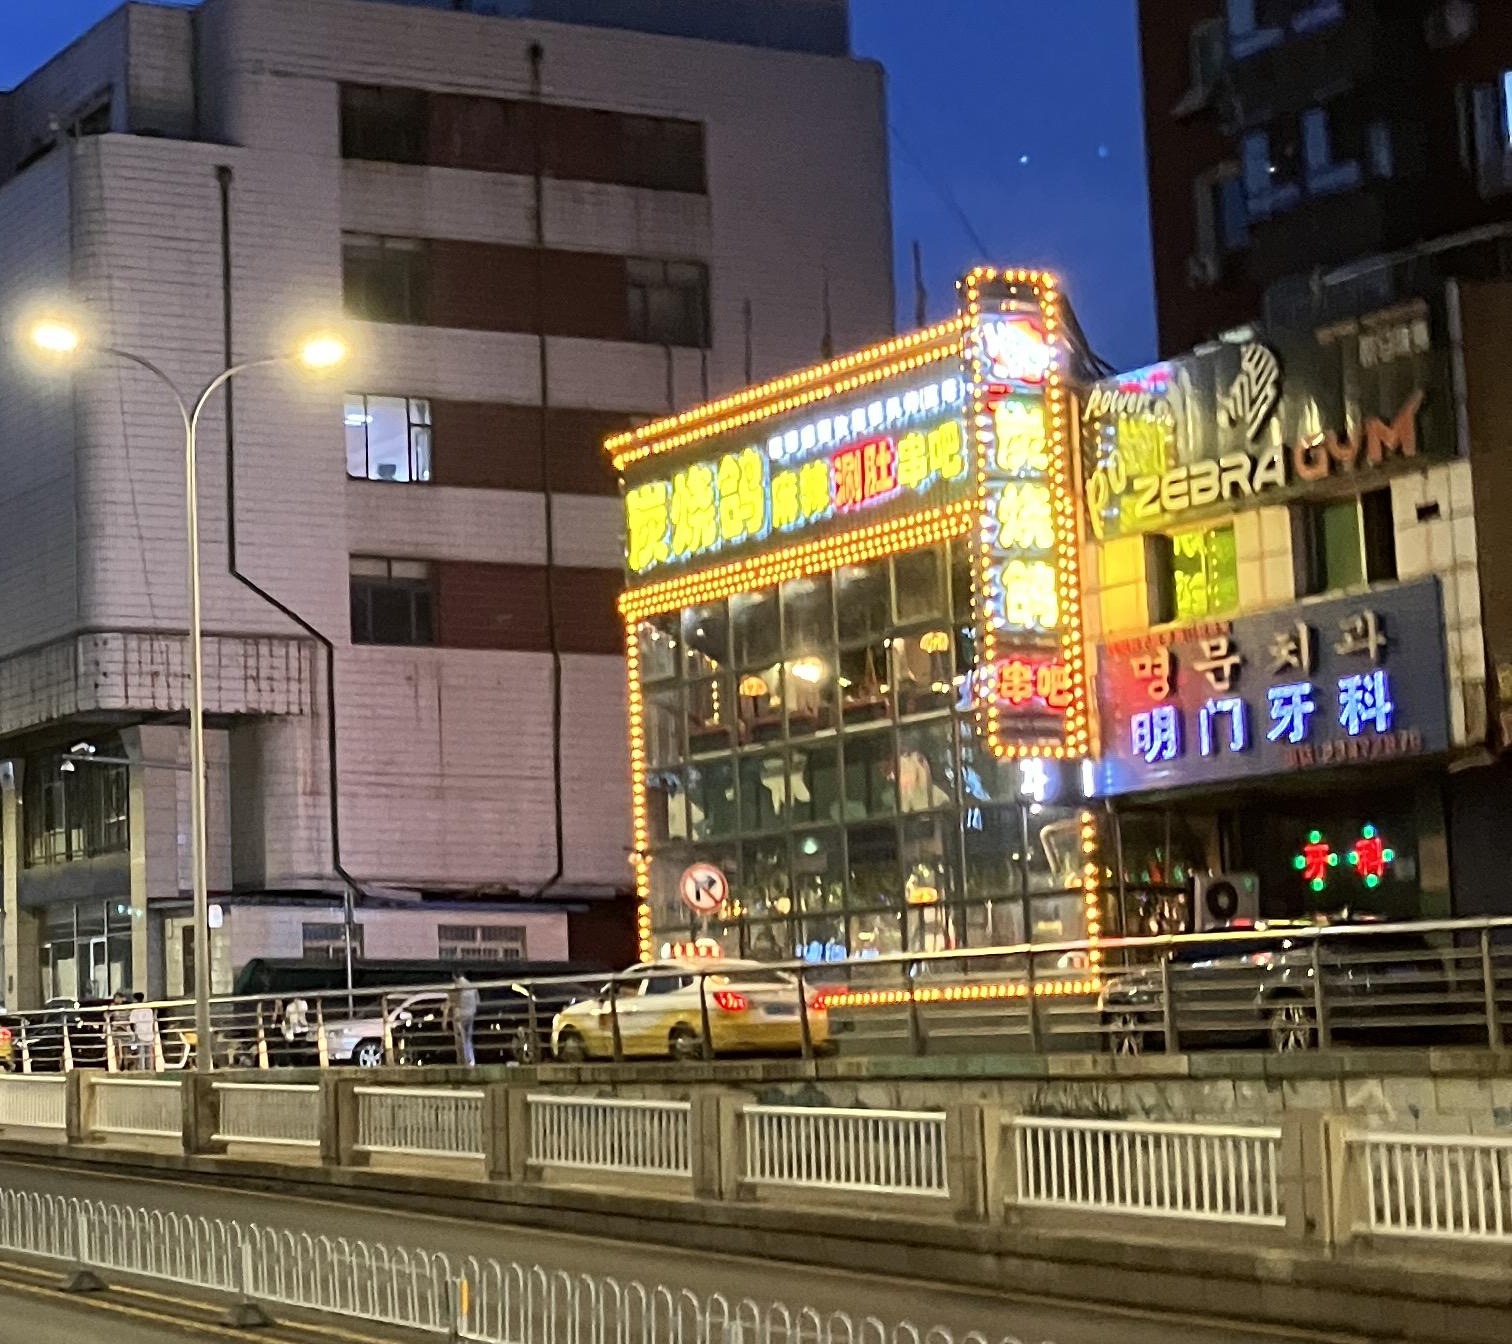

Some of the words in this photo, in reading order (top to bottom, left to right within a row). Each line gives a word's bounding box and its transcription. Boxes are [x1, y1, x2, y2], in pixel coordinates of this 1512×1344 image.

[626, 447, 764, 571] 炭烧鸽
[1133, 439, 1287, 518] ZEBRA
[1000, 659, 1072, 708] 串吧
[1131, 608, 1387, 701] 명문치과
[1131, 669, 1392, 763] 明门牙科
